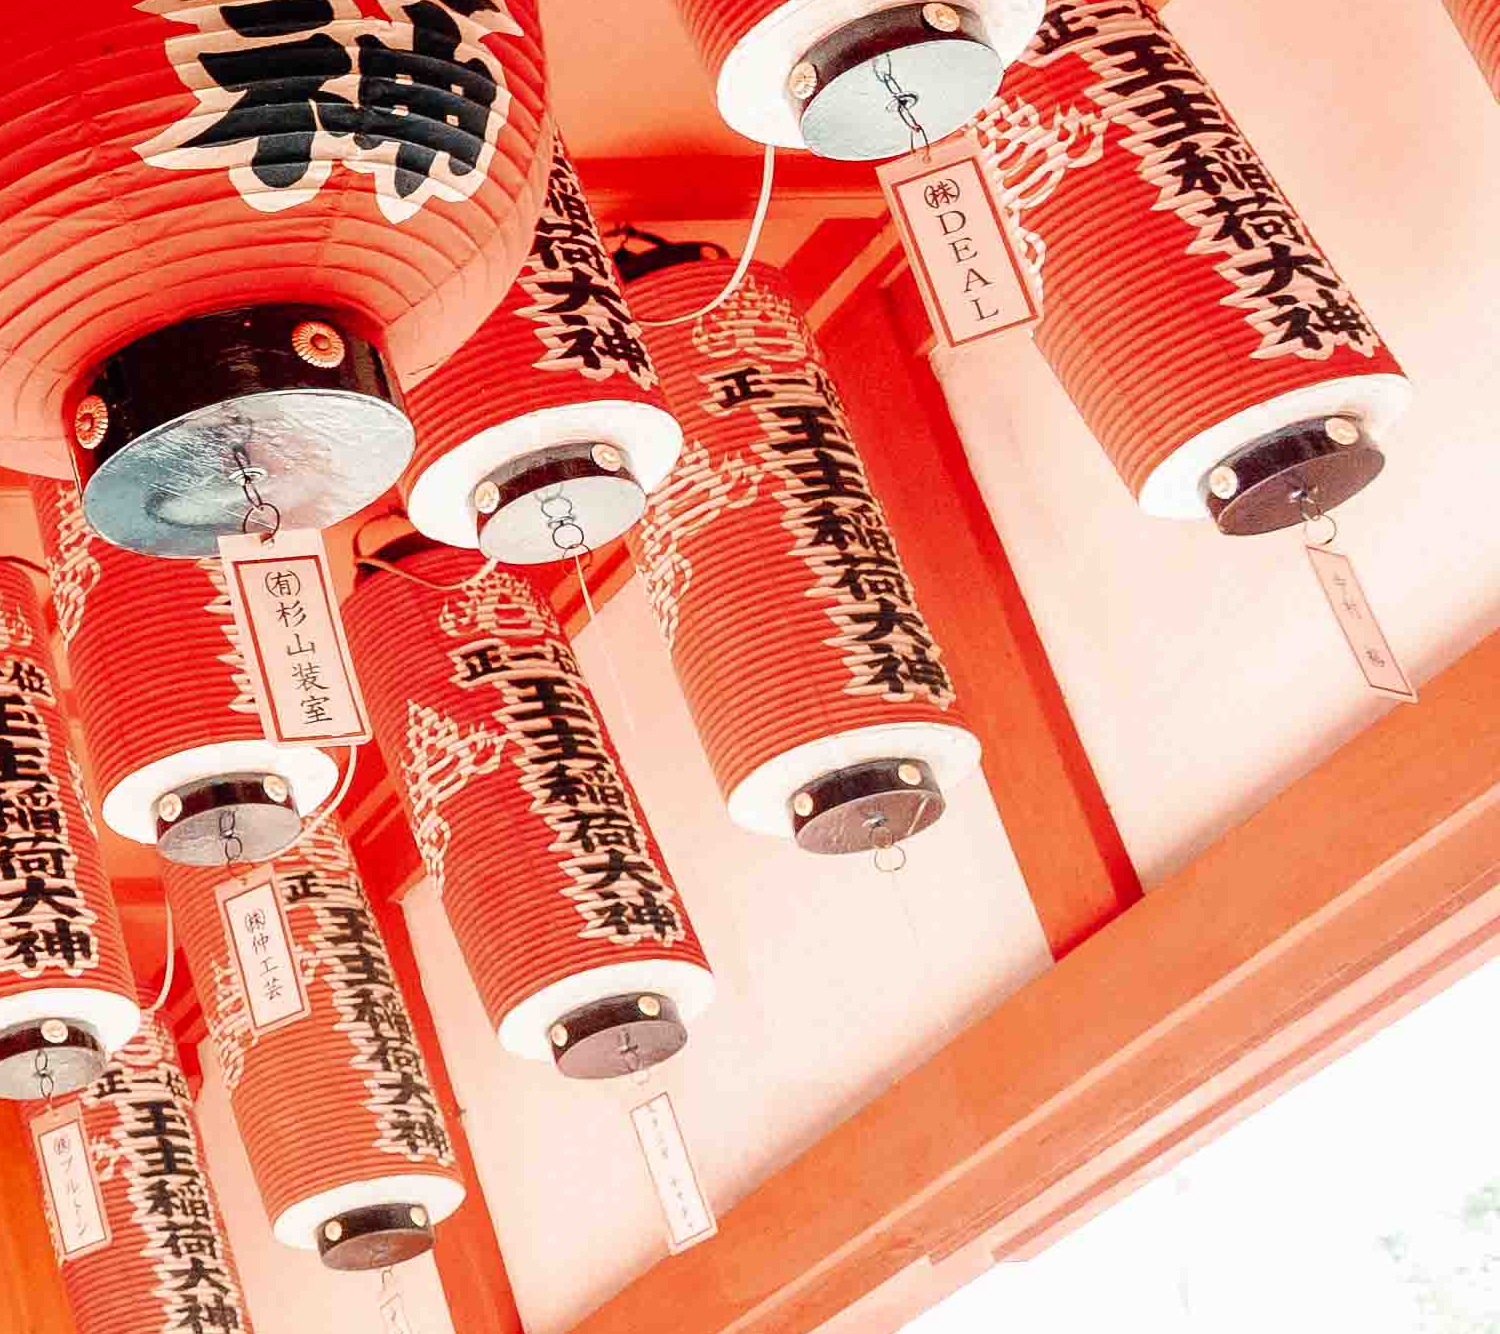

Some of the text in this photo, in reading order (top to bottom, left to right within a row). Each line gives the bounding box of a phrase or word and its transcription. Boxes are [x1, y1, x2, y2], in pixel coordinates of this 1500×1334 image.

[530, 147, 650, 375] 稲荷大神
[1094, 33, 1372, 351] 玉主稲荷大神
[765, 400, 952, 703] 玉主稲荷大神
[503, 676, 680, 942] 玉主稲荷大神
[320, 903, 452, 1161] 玉主稲荷大神
